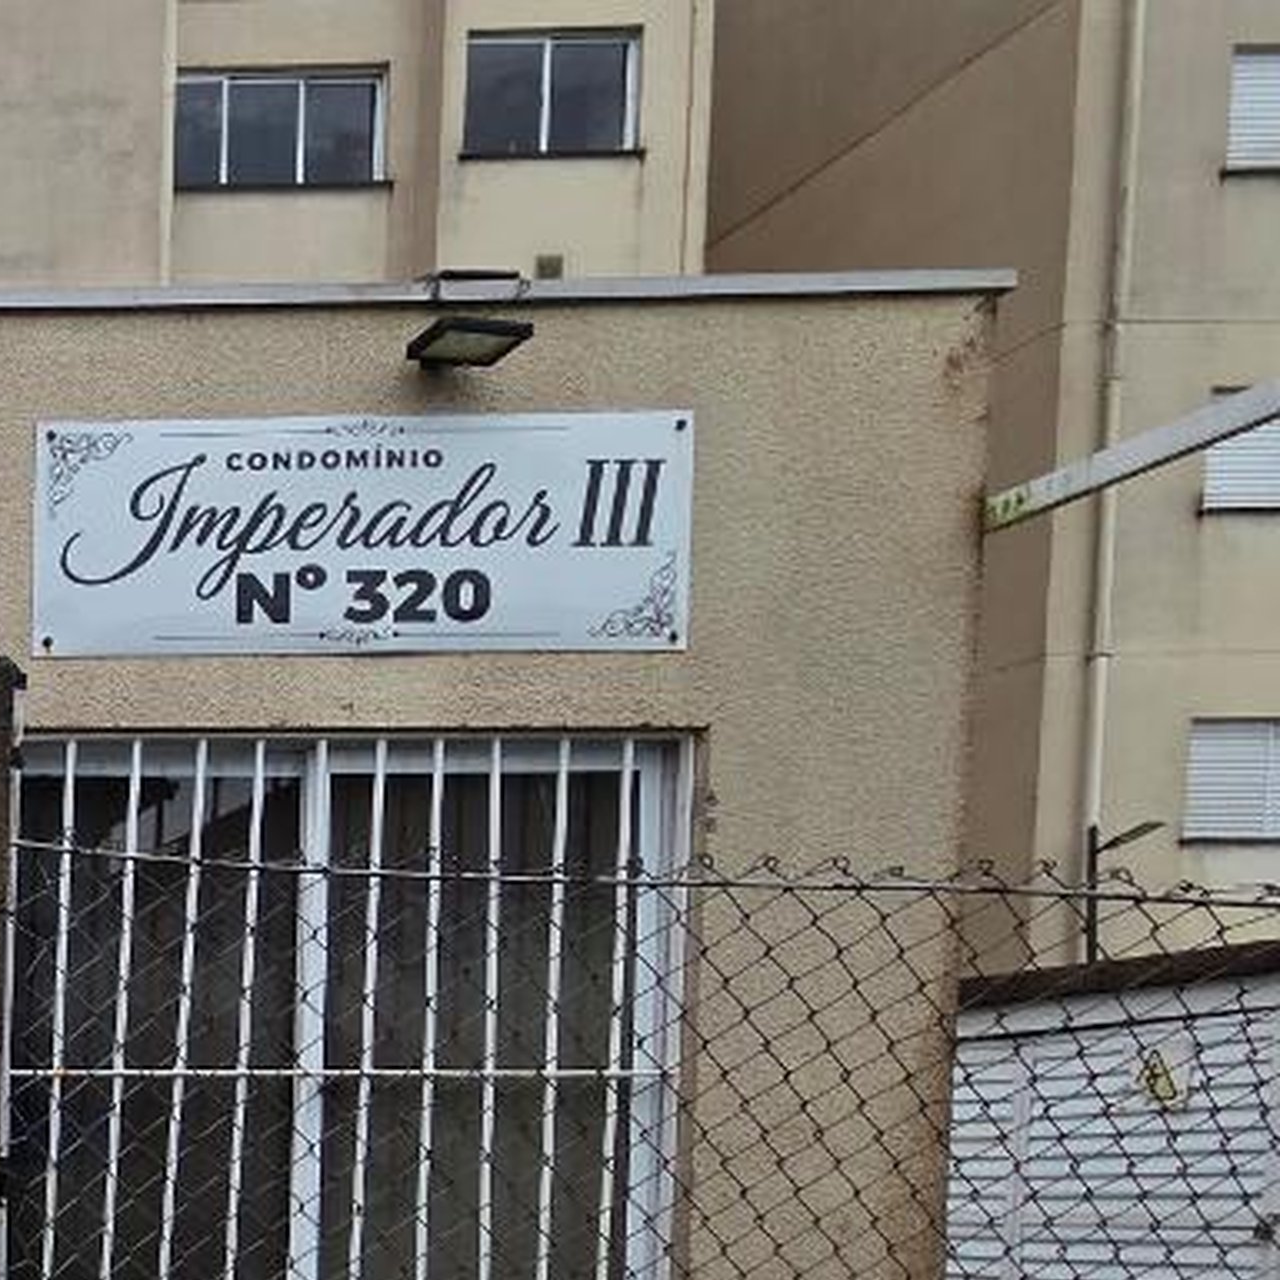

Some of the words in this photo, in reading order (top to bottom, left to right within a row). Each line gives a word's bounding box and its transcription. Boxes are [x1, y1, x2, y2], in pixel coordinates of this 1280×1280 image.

[225, 444, 444, 472] CONDOMÍNIO
[59, 453, 561, 601] Imperador
[571, 458, 667, 547] III
[236, 563, 328, 624] Nº
[342, 568, 493, 624] 320
